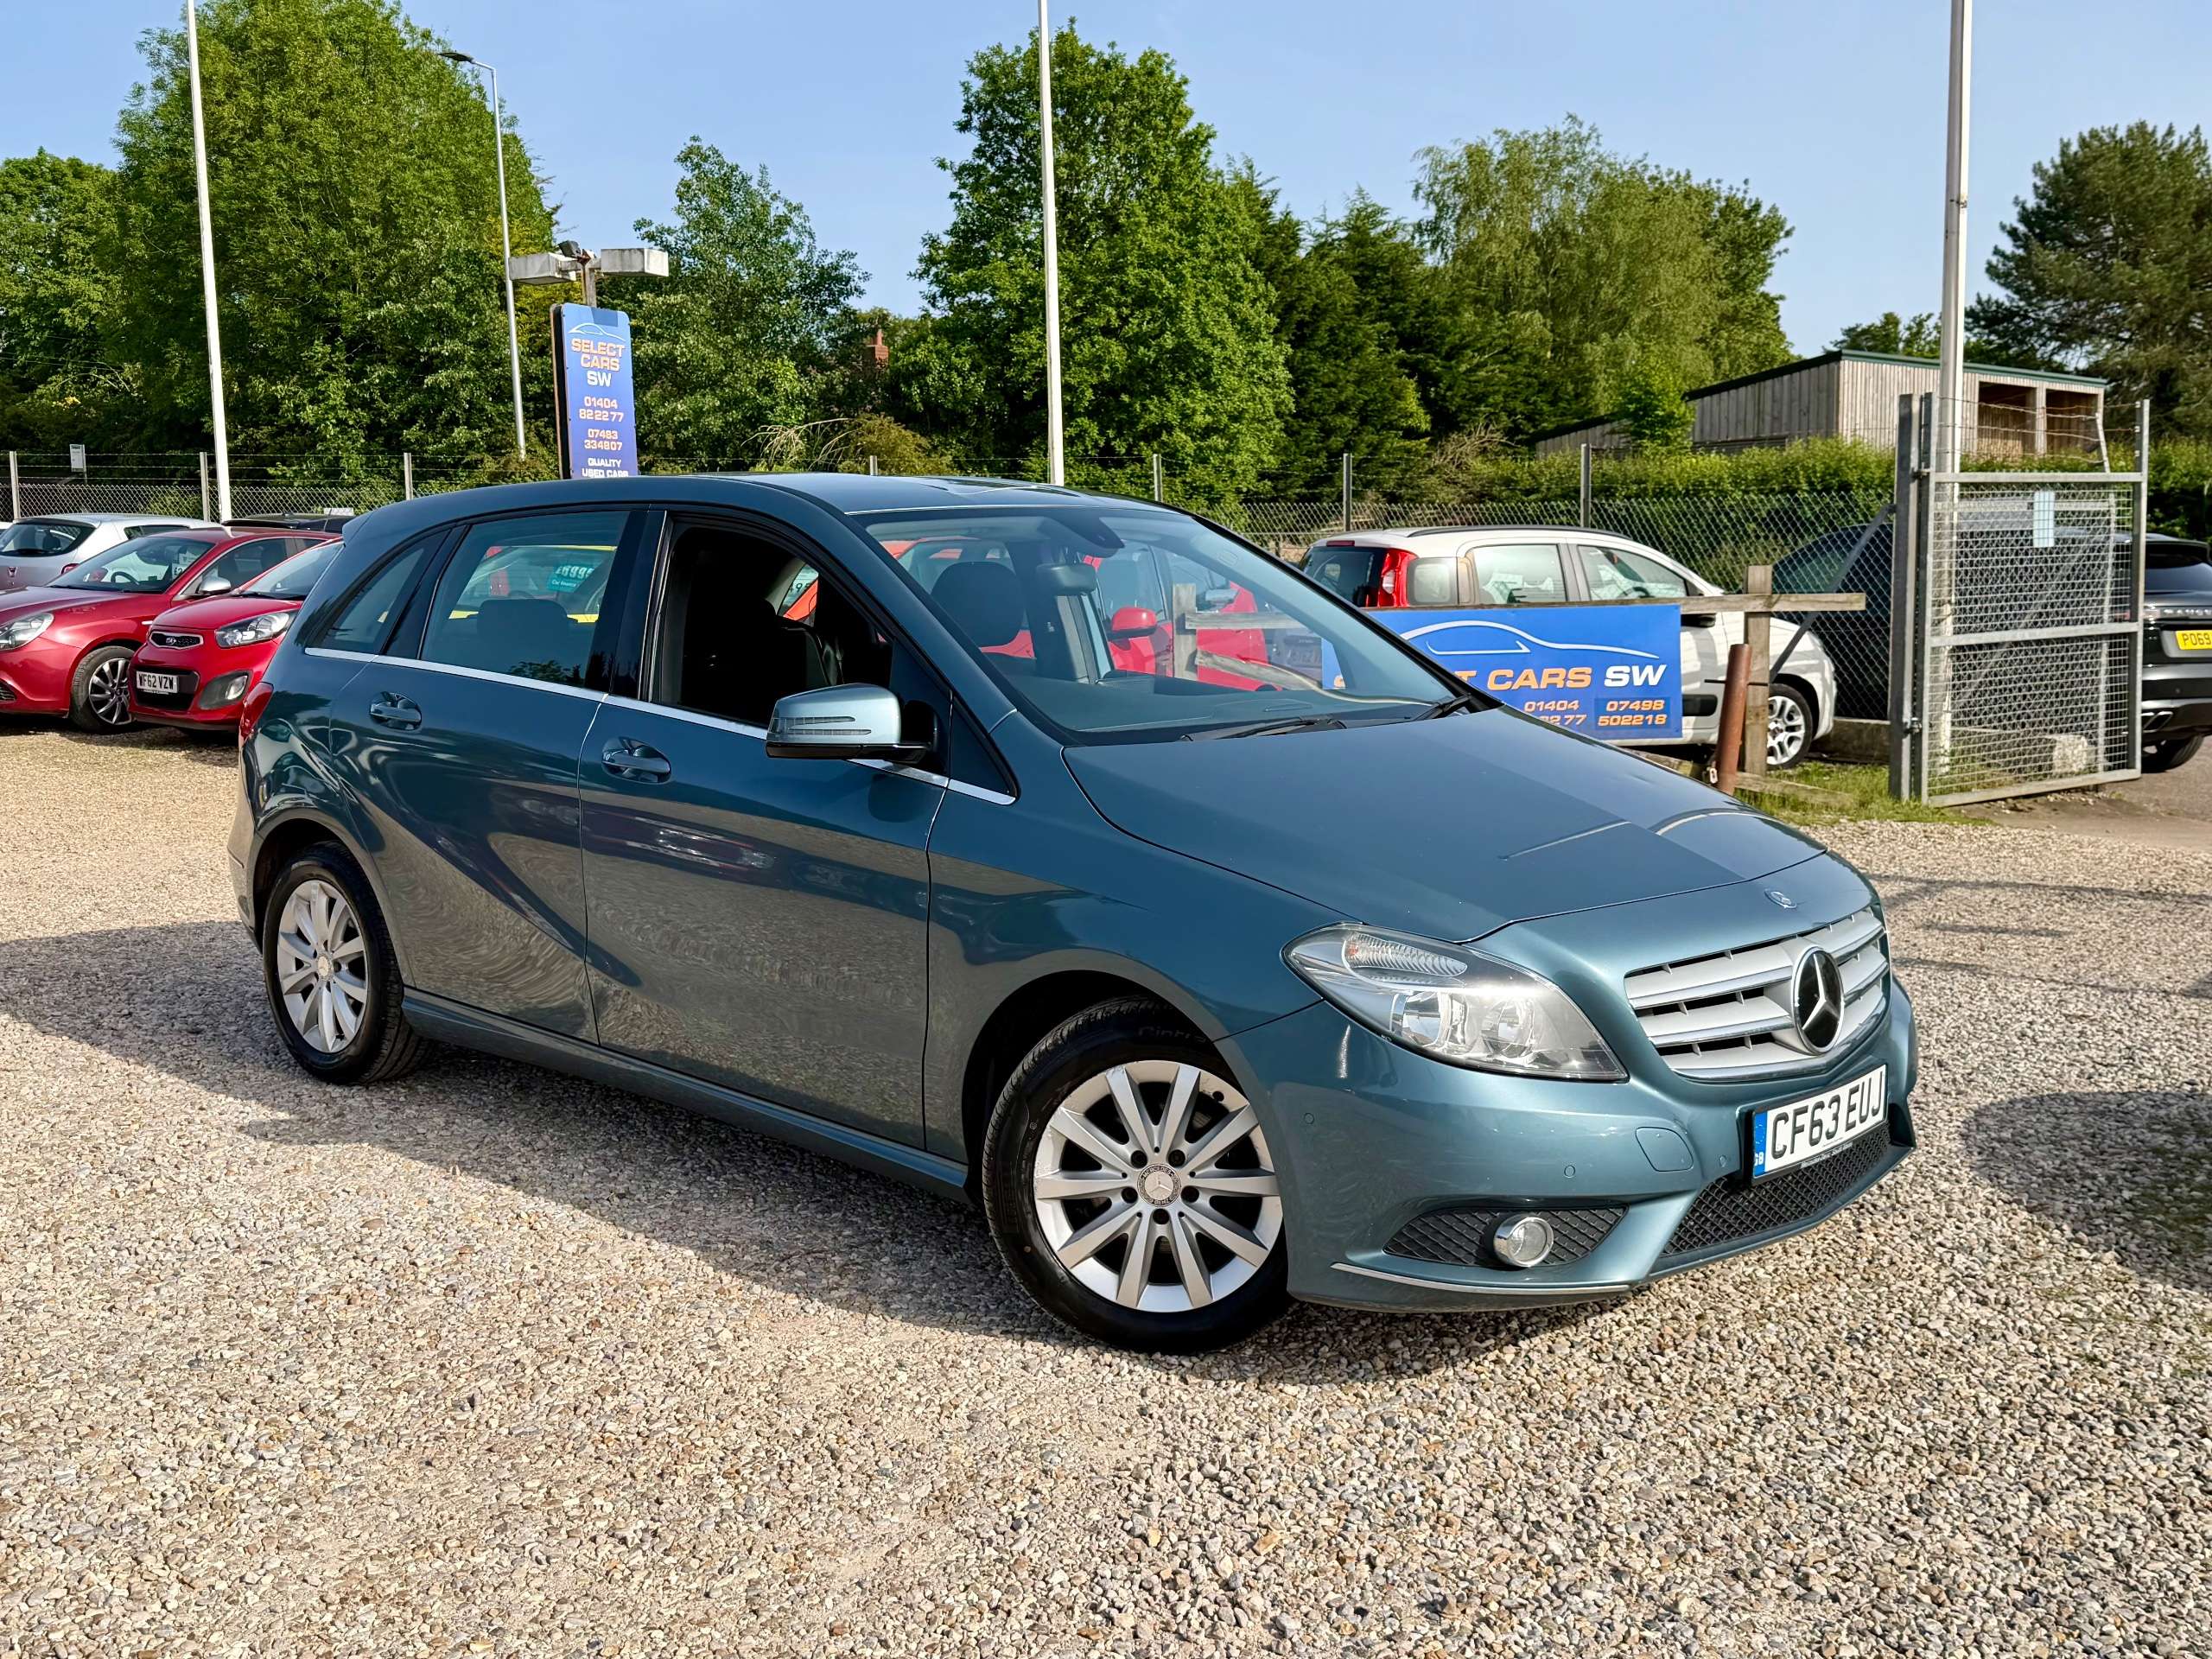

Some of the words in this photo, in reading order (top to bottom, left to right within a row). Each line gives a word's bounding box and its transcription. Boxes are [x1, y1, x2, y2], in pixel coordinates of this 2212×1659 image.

[571, 338, 626, 358] SELECT
[581, 356, 620, 372] CARS
[587, 371, 612, 387] SW
[584, 396, 618, 409] 01404
[588, 457, 621, 468] QUALITY
[138, 673, 157, 688] WF62
[158, 676, 175, 690] VZW
[1486, 666, 1593, 690] CARS
[1603, 664, 1667, 687] SW
[1524, 699, 1580, 713] 01404
[1597, 714, 1668, 727] 502218
[1771, 1094, 1841, 1160] CF63
[1845, 1071, 1884, 1133] EUJ
